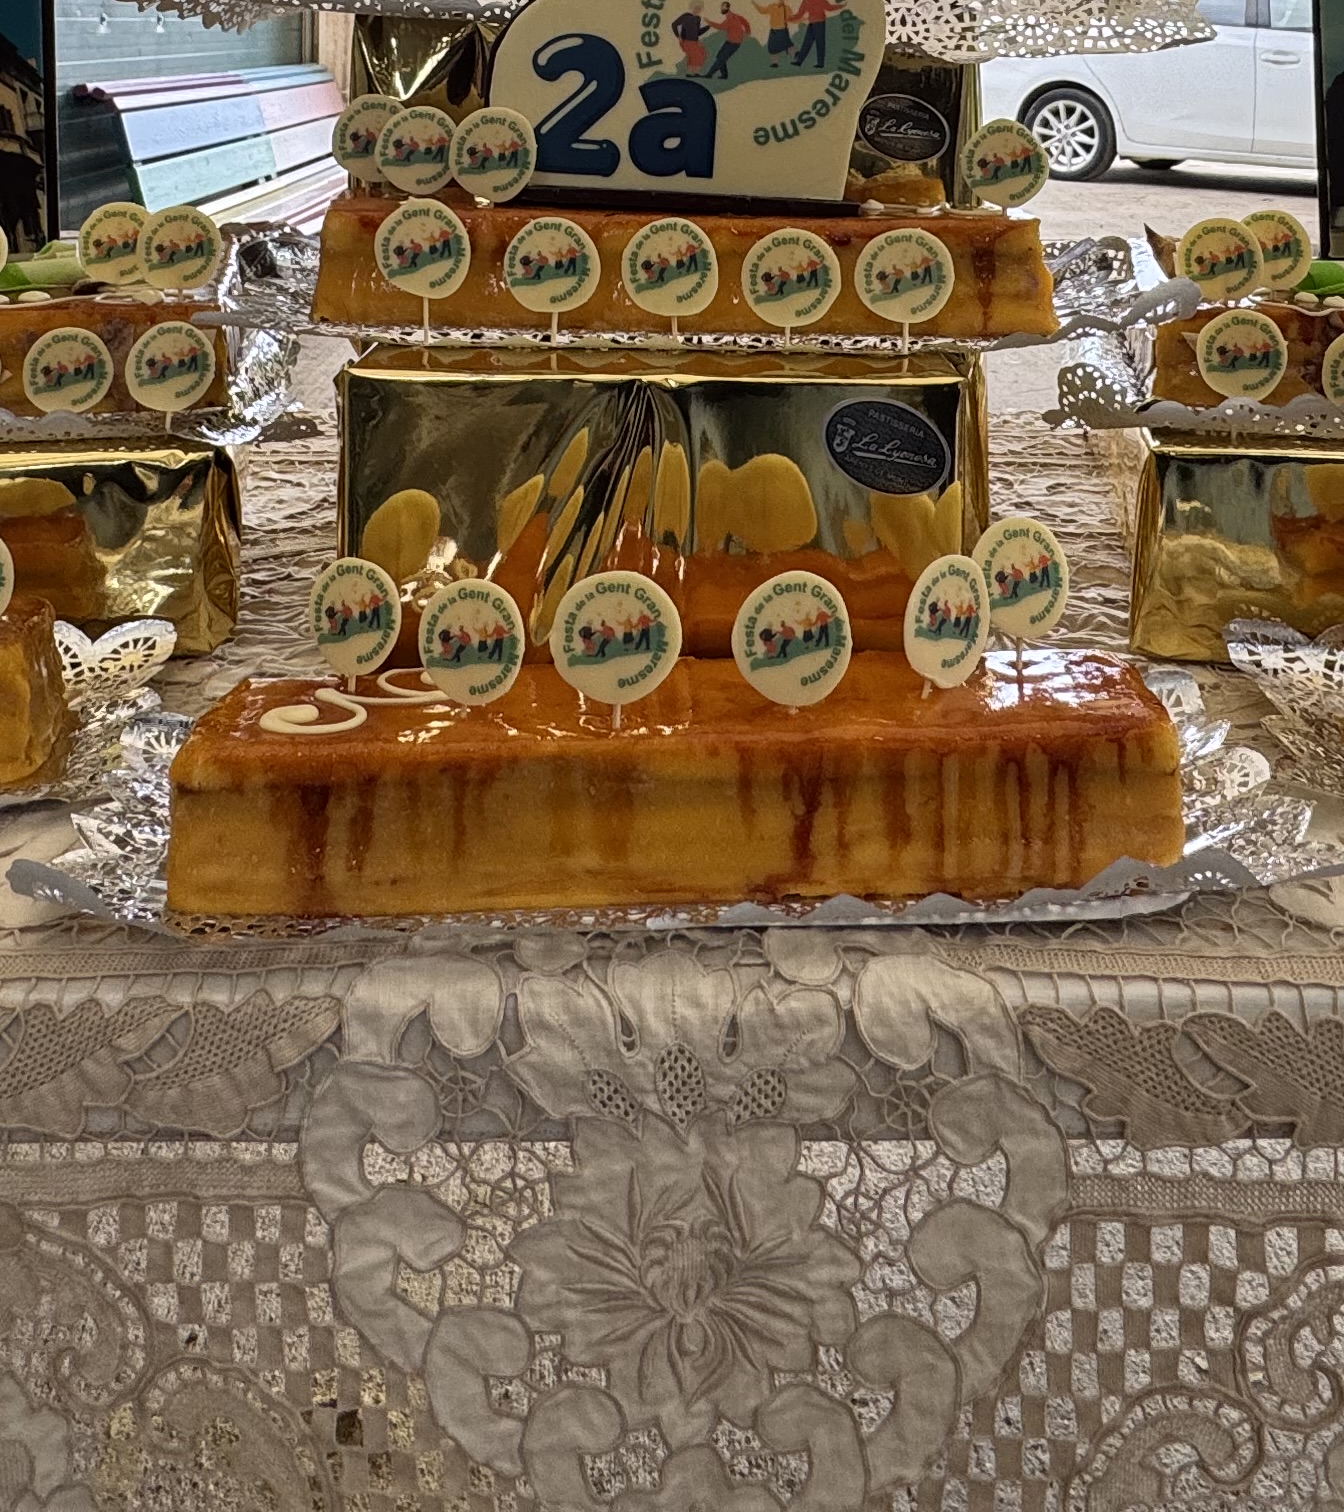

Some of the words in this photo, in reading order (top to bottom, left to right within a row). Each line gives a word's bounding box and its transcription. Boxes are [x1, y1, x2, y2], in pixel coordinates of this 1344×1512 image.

[532, 32, 718, 179] 2a
[752, 51, 866, 146] Maresme
[437, 117, 453, 138] Gra
[1003, 528, 1029, 540] Gent
[1032, 530, 1055, 558] Gran
[336, 564, 363, 576] Gent
[366, 569, 387, 598] Gran
[773, 582, 806, 596] Gent
[810, 585, 837, 615] Gran
[947, 564, 969, 582] Gent
[969, 578, 981, 610] Gran
[457, 588, 490, 603] Gent
[492, 597, 514, 630] Gran
[595, 582, 630, 594] Gent
[634, 587, 660, 619] Gran
